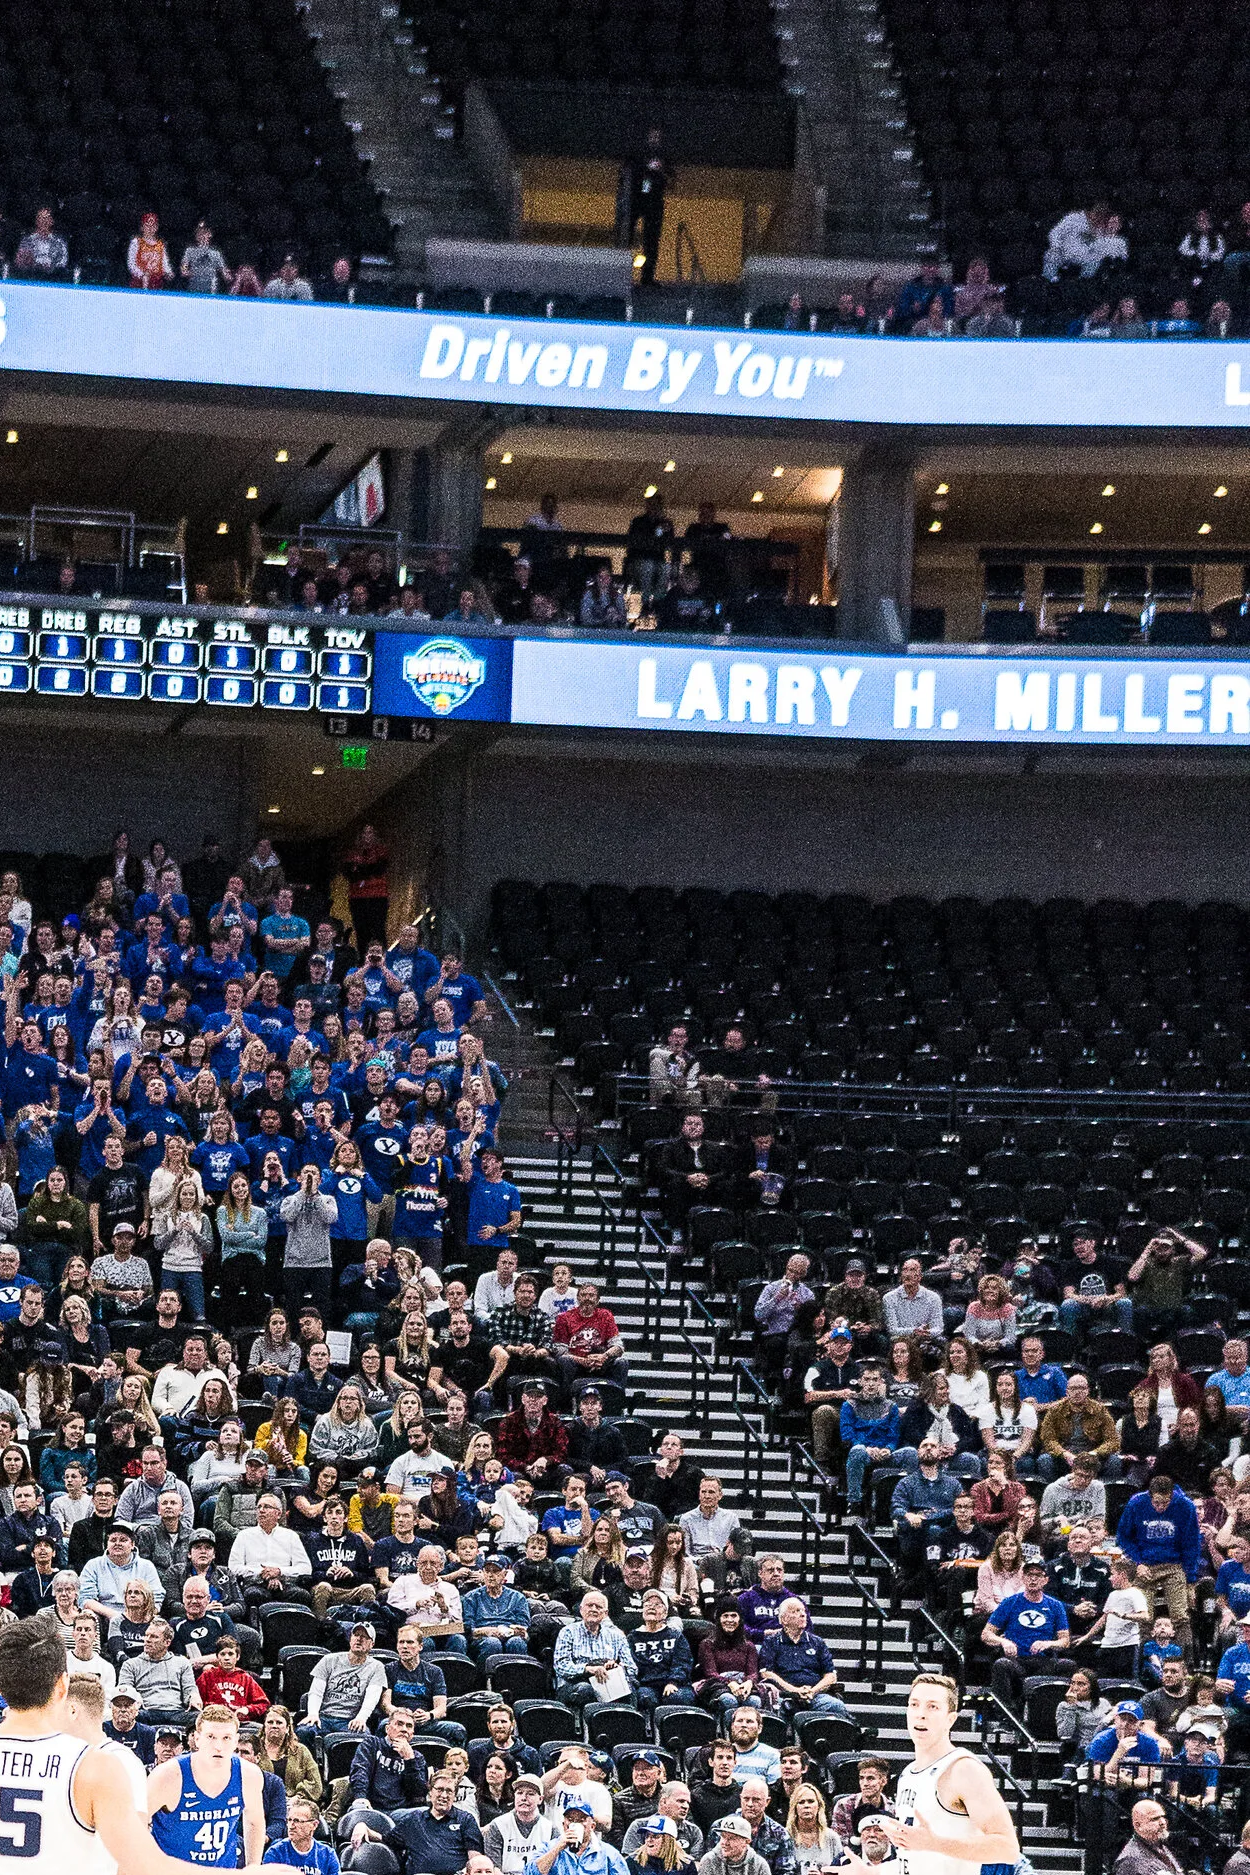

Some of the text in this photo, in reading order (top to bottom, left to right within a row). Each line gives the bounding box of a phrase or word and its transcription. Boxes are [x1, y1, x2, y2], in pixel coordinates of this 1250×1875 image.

[419, 323, 609, 388] Driven
[623, 337, 702, 404] By
[99, 612, 141, 634] REB
[156, 617, 199, 638] AST
[214, 622, 251, 642] STL
[267, 625, 310, 646] BLK
[324, 629, 367, 649] TOV
[57, 636, 69, 657] 1
[168, 643, 185, 664] 0
[280, 650, 298, 671] 0
[338, 654, 351, 675] 1
[166, 676, 183, 697] 0
[223, 679, 240, 701] 0
[279, 683, 296, 705] 0
[337, 686, 350, 708] 1
[636, 659, 1250, 734] LARRY H. MILLER
[316, 1549, 357, 1563] COUGARS
[634, 1639, 676, 1653] BYU
[394, 1683, 427, 1696] SOCCER
[39, 1754, 61, 1779] JR
[180, 1806, 241, 1821] BRIGHAM
[194, 1820, 230, 1851] 40
[506, 1844, 538, 1854] BRIGHA
